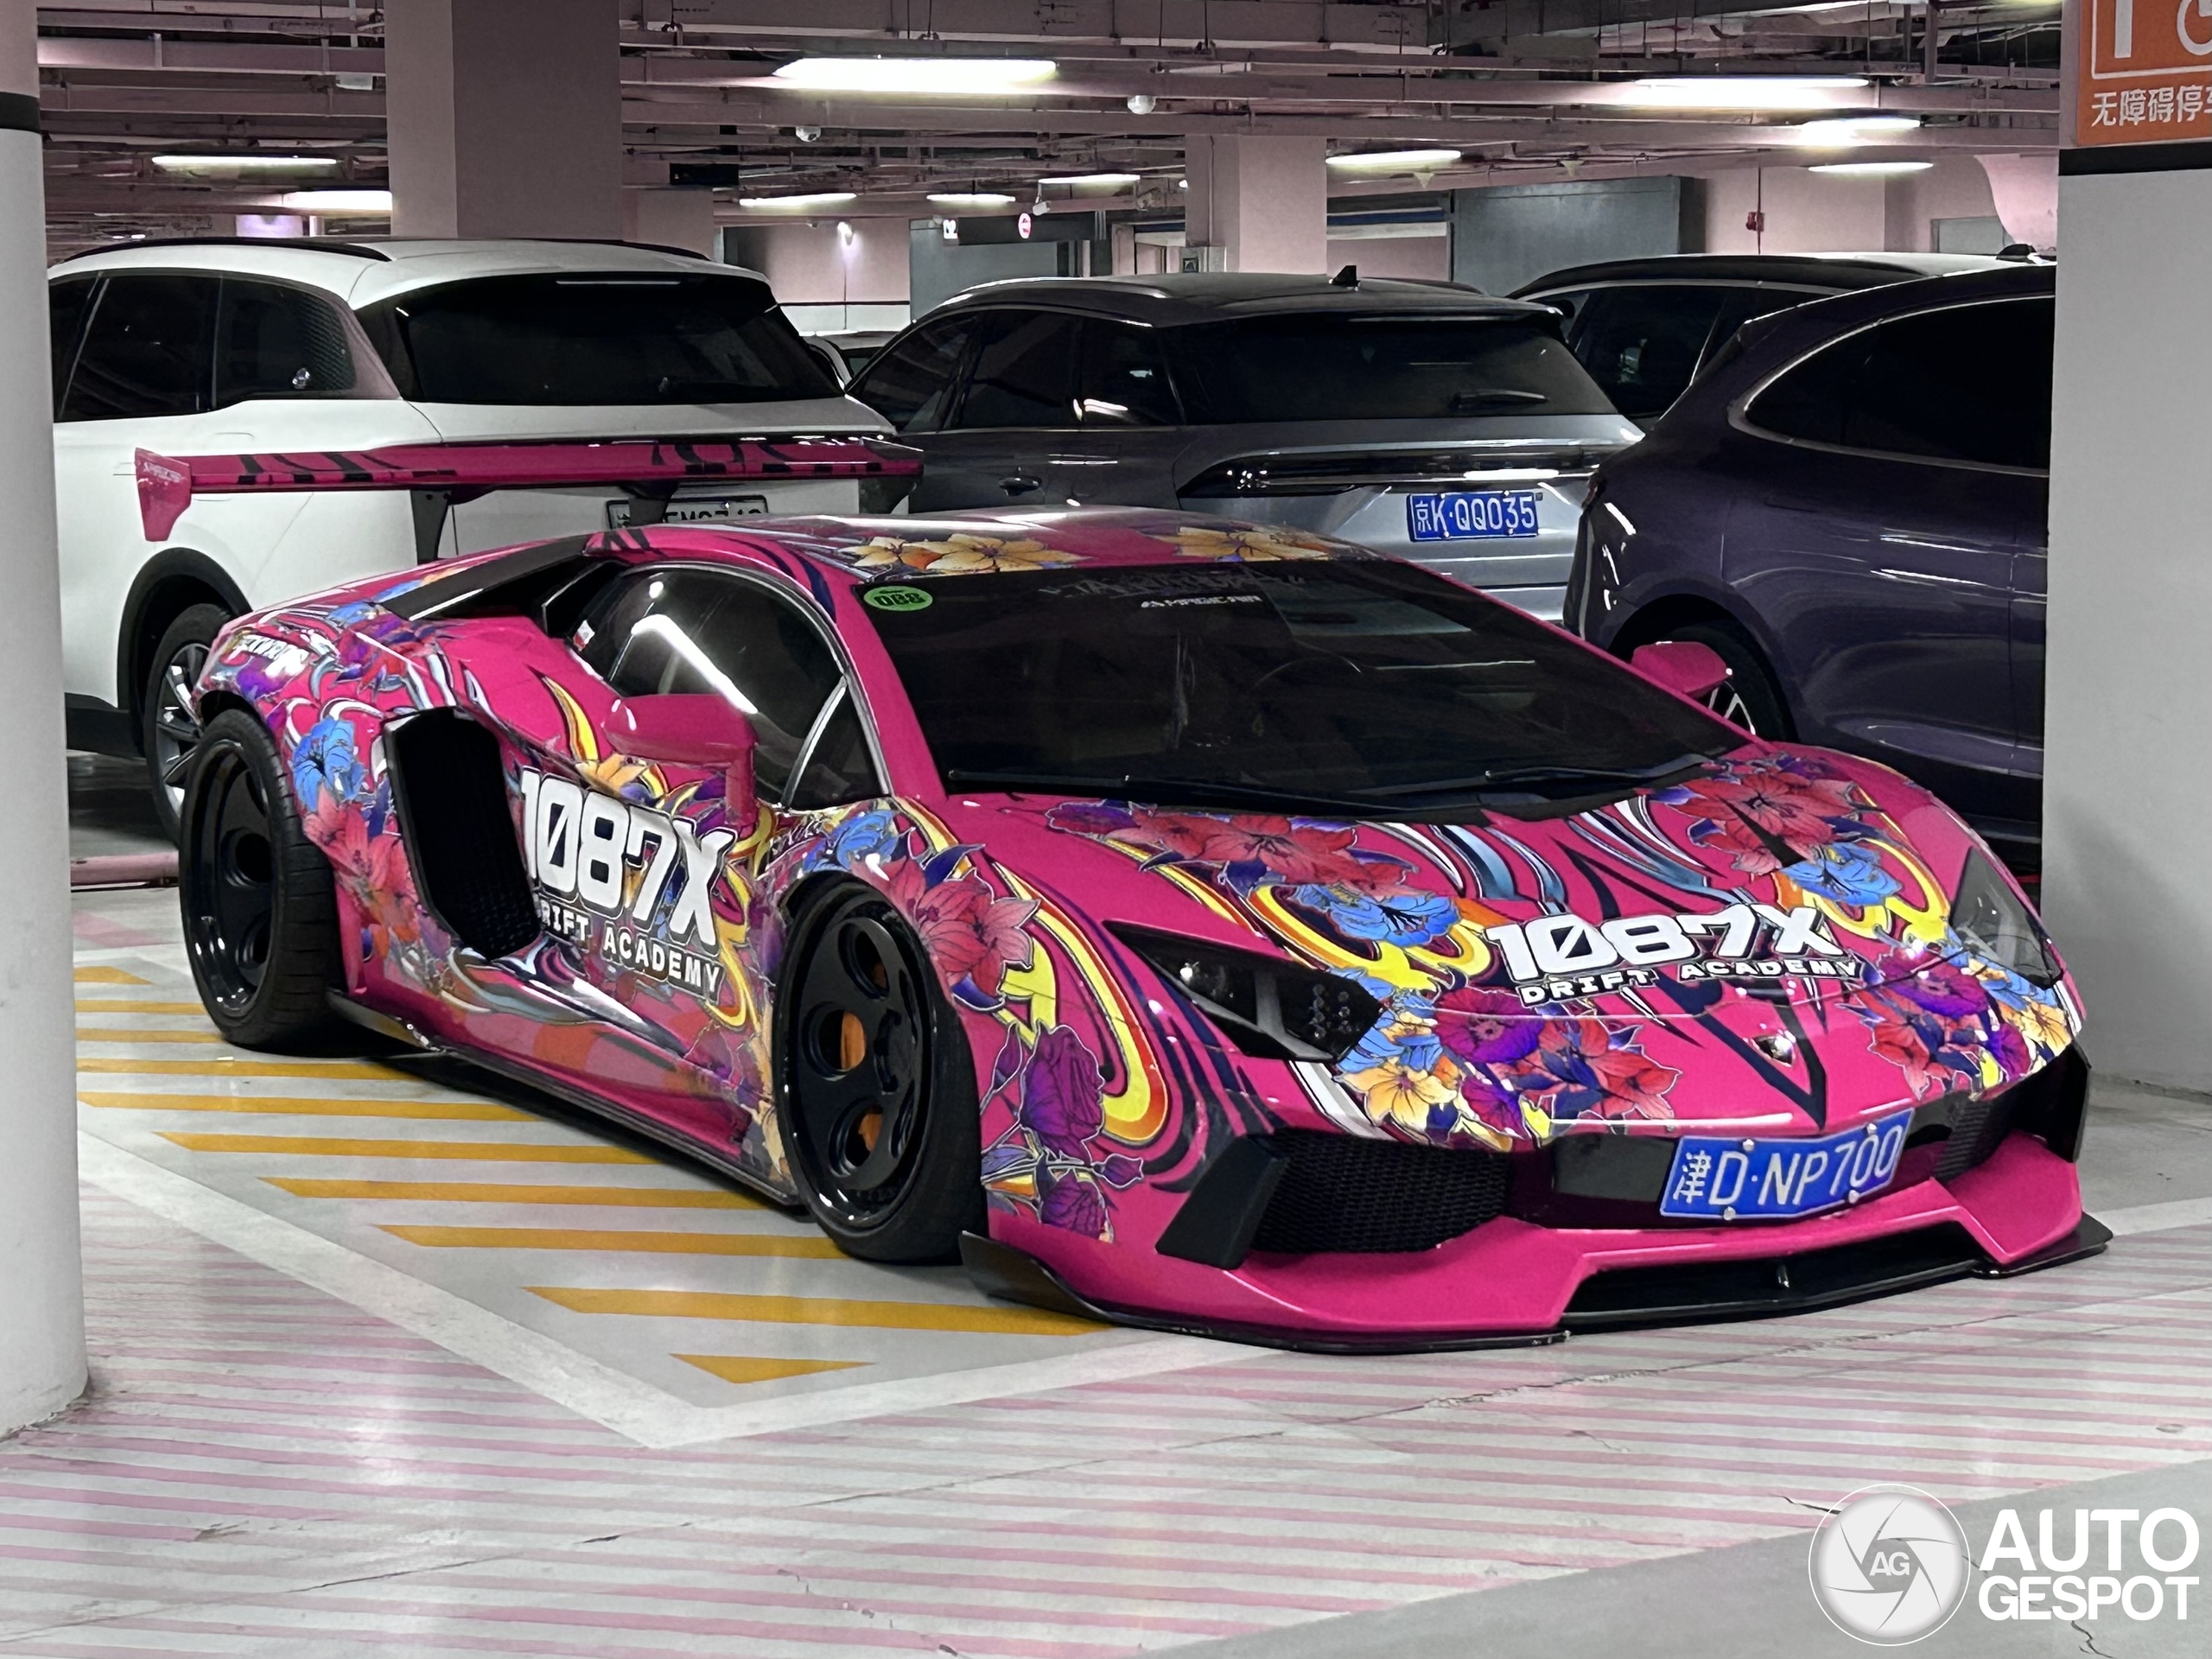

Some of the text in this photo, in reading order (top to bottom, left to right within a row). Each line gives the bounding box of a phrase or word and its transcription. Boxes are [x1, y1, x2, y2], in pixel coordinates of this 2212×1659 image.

[520, 769, 735, 947] 1087X
[603, 925, 721, 993] ACADEMY
[1484, 903, 1845, 982] 1087X
[1520, 960, 1859, 1004] DRIFT ACADEMY
